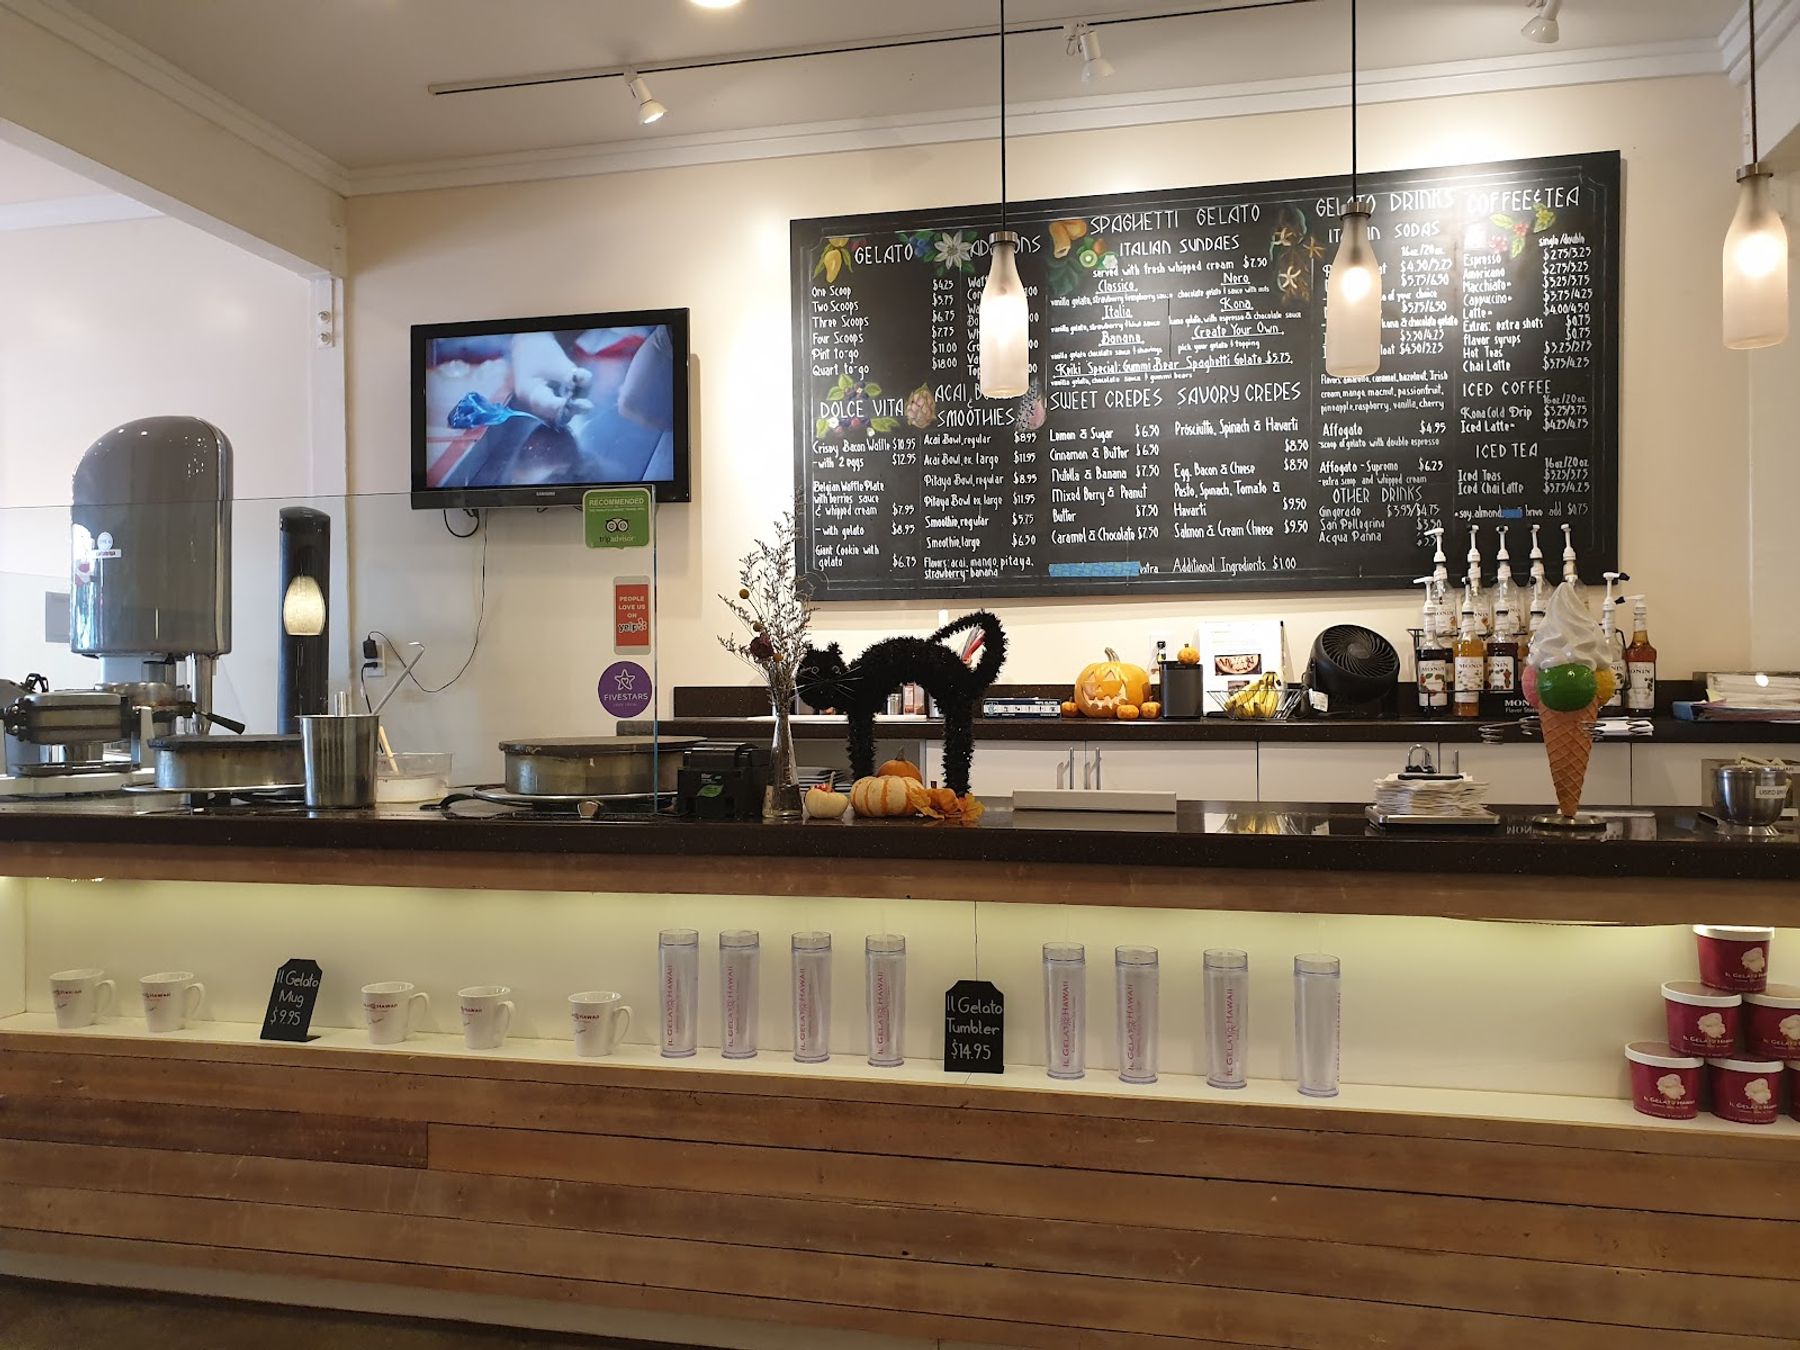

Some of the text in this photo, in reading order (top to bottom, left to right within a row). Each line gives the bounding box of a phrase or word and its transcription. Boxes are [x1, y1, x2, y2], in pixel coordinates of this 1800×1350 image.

[1545, 186, 1579, 208] TEA
[1090, 204, 1260, 235] SPAGHETTI GELATO
[1394, 220, 1440, 238] SODAS
[1120, 234, 1240, 256] ITALIAN SUNDAES
[855, 244, 914, 264] GELATO
[1092, 254, 1268, 278] served with fresh whipped cream $7.50
[812, 286, 851, 299] One Scoop
[1098, 279, 1134, 292] Classico
[812, 300, 858, 315] Two Scoops
[1220, 297, 1251, 310] Kona
[812, 315, 869, 330] Three Scoops
[932, 310, 955, 322] $6.75
[1496, 320, 1520, 331] extra
[1522, 317, 1543, 329] shots
[1565, 314, 1590, 327] $0.75
[932, 325, 954, 338] $7.75
[1101, 330, 1141, 344] Banana
[1194, 321, 1278, 338] Create Your Own
[813, 331, 864, 347] Four Scoops
[1463, 335, 1490, 346] flavor
[1494, 334, 1521, 348] syrups
[812, 364, 838, 376] Quart
[935, 383, 966, 402] ACAI
[1177, 382, 1301, 406] SAVORY CREPES
[1463, 380, 1552, 397] ICED COFFEE
[1050, 388, 1163, 410] SWEET CREPES
[820, 399, 904, 418] DOLCE VITA
[937, 408, 1015, 428] SMOOTHIES
[1050, 429, 1076, 442] Lemon
[1090, 427, 1114, 444] Sugar
[1135, 423, 1160, 438] $6.50
[1322, 419, 1446, 440] Affogato $4.95
[842, 439, 866, 453] Bacon
[866, 438, 890, 451] Waffle
[892, 437, 915, 450] $10.95
[1050, 448, 1088, 461] Cinnamon
[1104, 445, 1129, 460] Butter
[1136, 444, 1160, 457] $6.50
[1285, 438, 1309, 452] $8.50
[1476, 442, 1538, 458] ICED TEA
[1052, 467, 1080, 482] Nutella
[1096, 466, 1127, 480] Banana
[1136, 464, 1160, 478] $7.50
[813, 480, 885, 494] Belgian Waffle Plate
[1052, 487, 1081, 503] Mixed
[1083, 486, 1105, 506] Berry
[1121, 483, 1147, 499] Peanut
[1332, 485, 1423, 504] OTHER DRINKS
[589, 498, 644, 506] RECOMMENDED
[859, 495, 879, 503] sauce
[1173, 497, 1307, 517] Havarti $9.50
[1053, 508, 1077, 523] Butter
[1052, 527, 1087, 544] Caramel
[1098, 526, 1135, 542] Chocolate
[1137, 526, 1159, 540] $7.50
[1174, 522, 1204, 539] Salmon
[1218, 520, 1244, 537] Cream
[1246, 519, 1274, 536] Cheese
[1284, 519, 1308, 534] $9.50
[1318, 532, 1382, 546] Acqua Panna
[815, 544, 880, 556] Giant Cookie with
[819, 556, 843, 571] gelato
[1172, 556, 1215, 573] Additional
[1220, 556, 1266, 576] Ingredients
[604, 692, 648, 701] FIVESTARS
[286, 970, 319, 987] Gelato
[279, 989, 304, 1008] Mug
[958, 997, 1003, 1014] Gelato
[270, 1006, 300, 1025] $9.95
[946, 1017, 1000, 1035] Tumbler
[951, 1039, 991, 1060] $14.95
